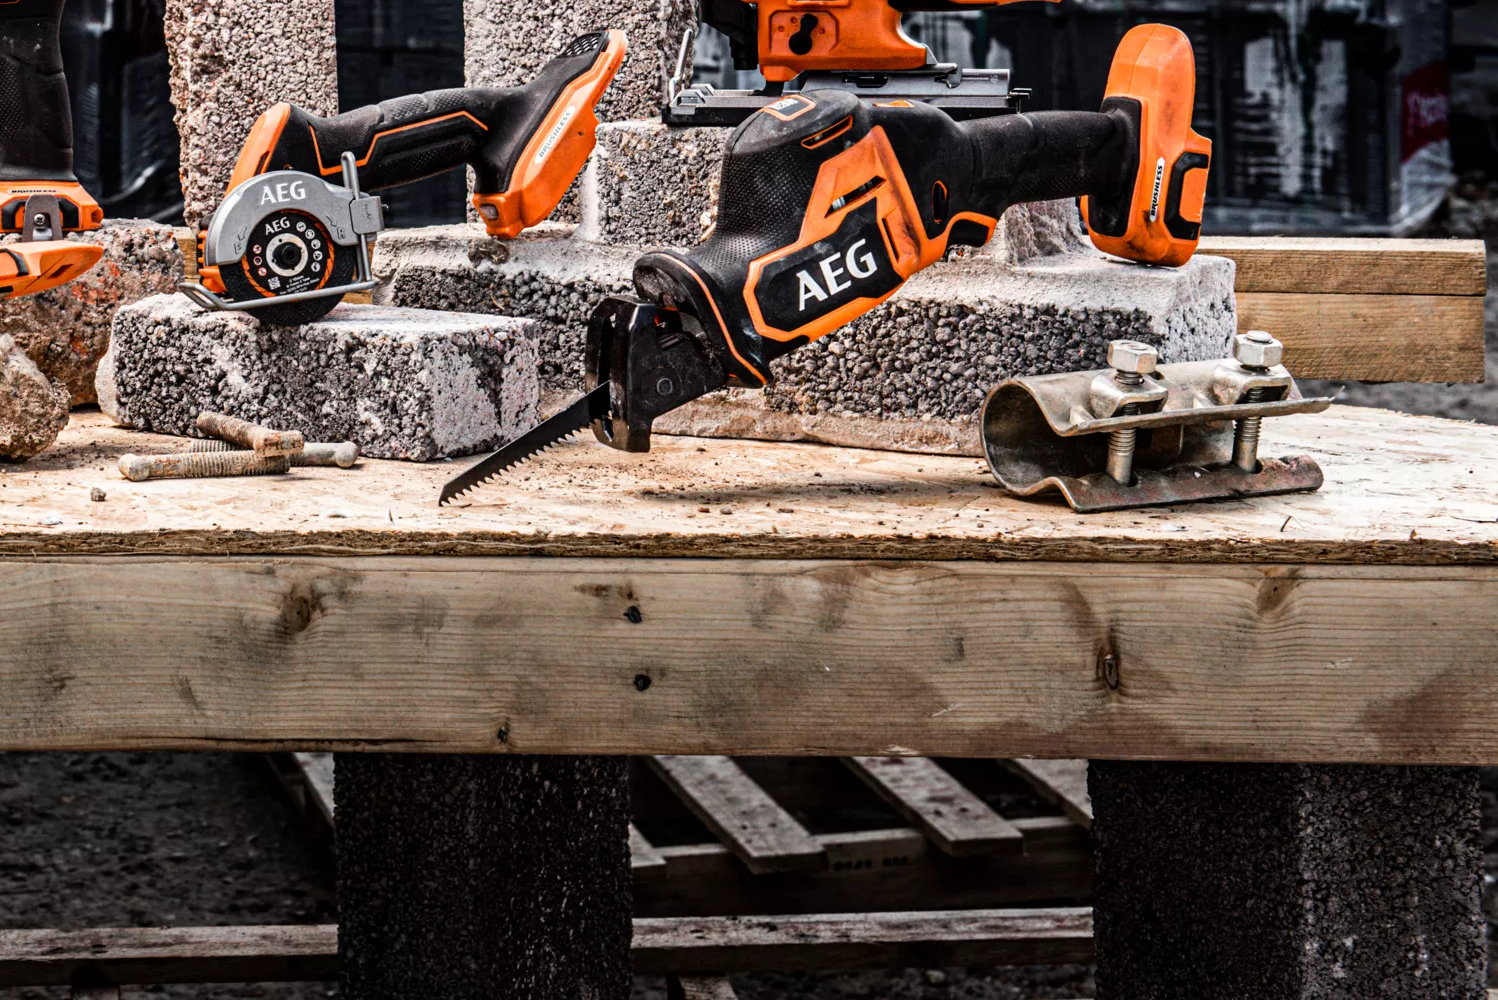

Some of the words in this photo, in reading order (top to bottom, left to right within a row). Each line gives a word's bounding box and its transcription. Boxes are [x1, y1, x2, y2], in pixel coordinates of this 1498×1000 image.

[260, 180, 307, 206] AEG
[1150, 164, 1163, 217] BRUSHLESS
[265, 216, 291, 236] AEG
[796, 238, 878, 312] AEG
